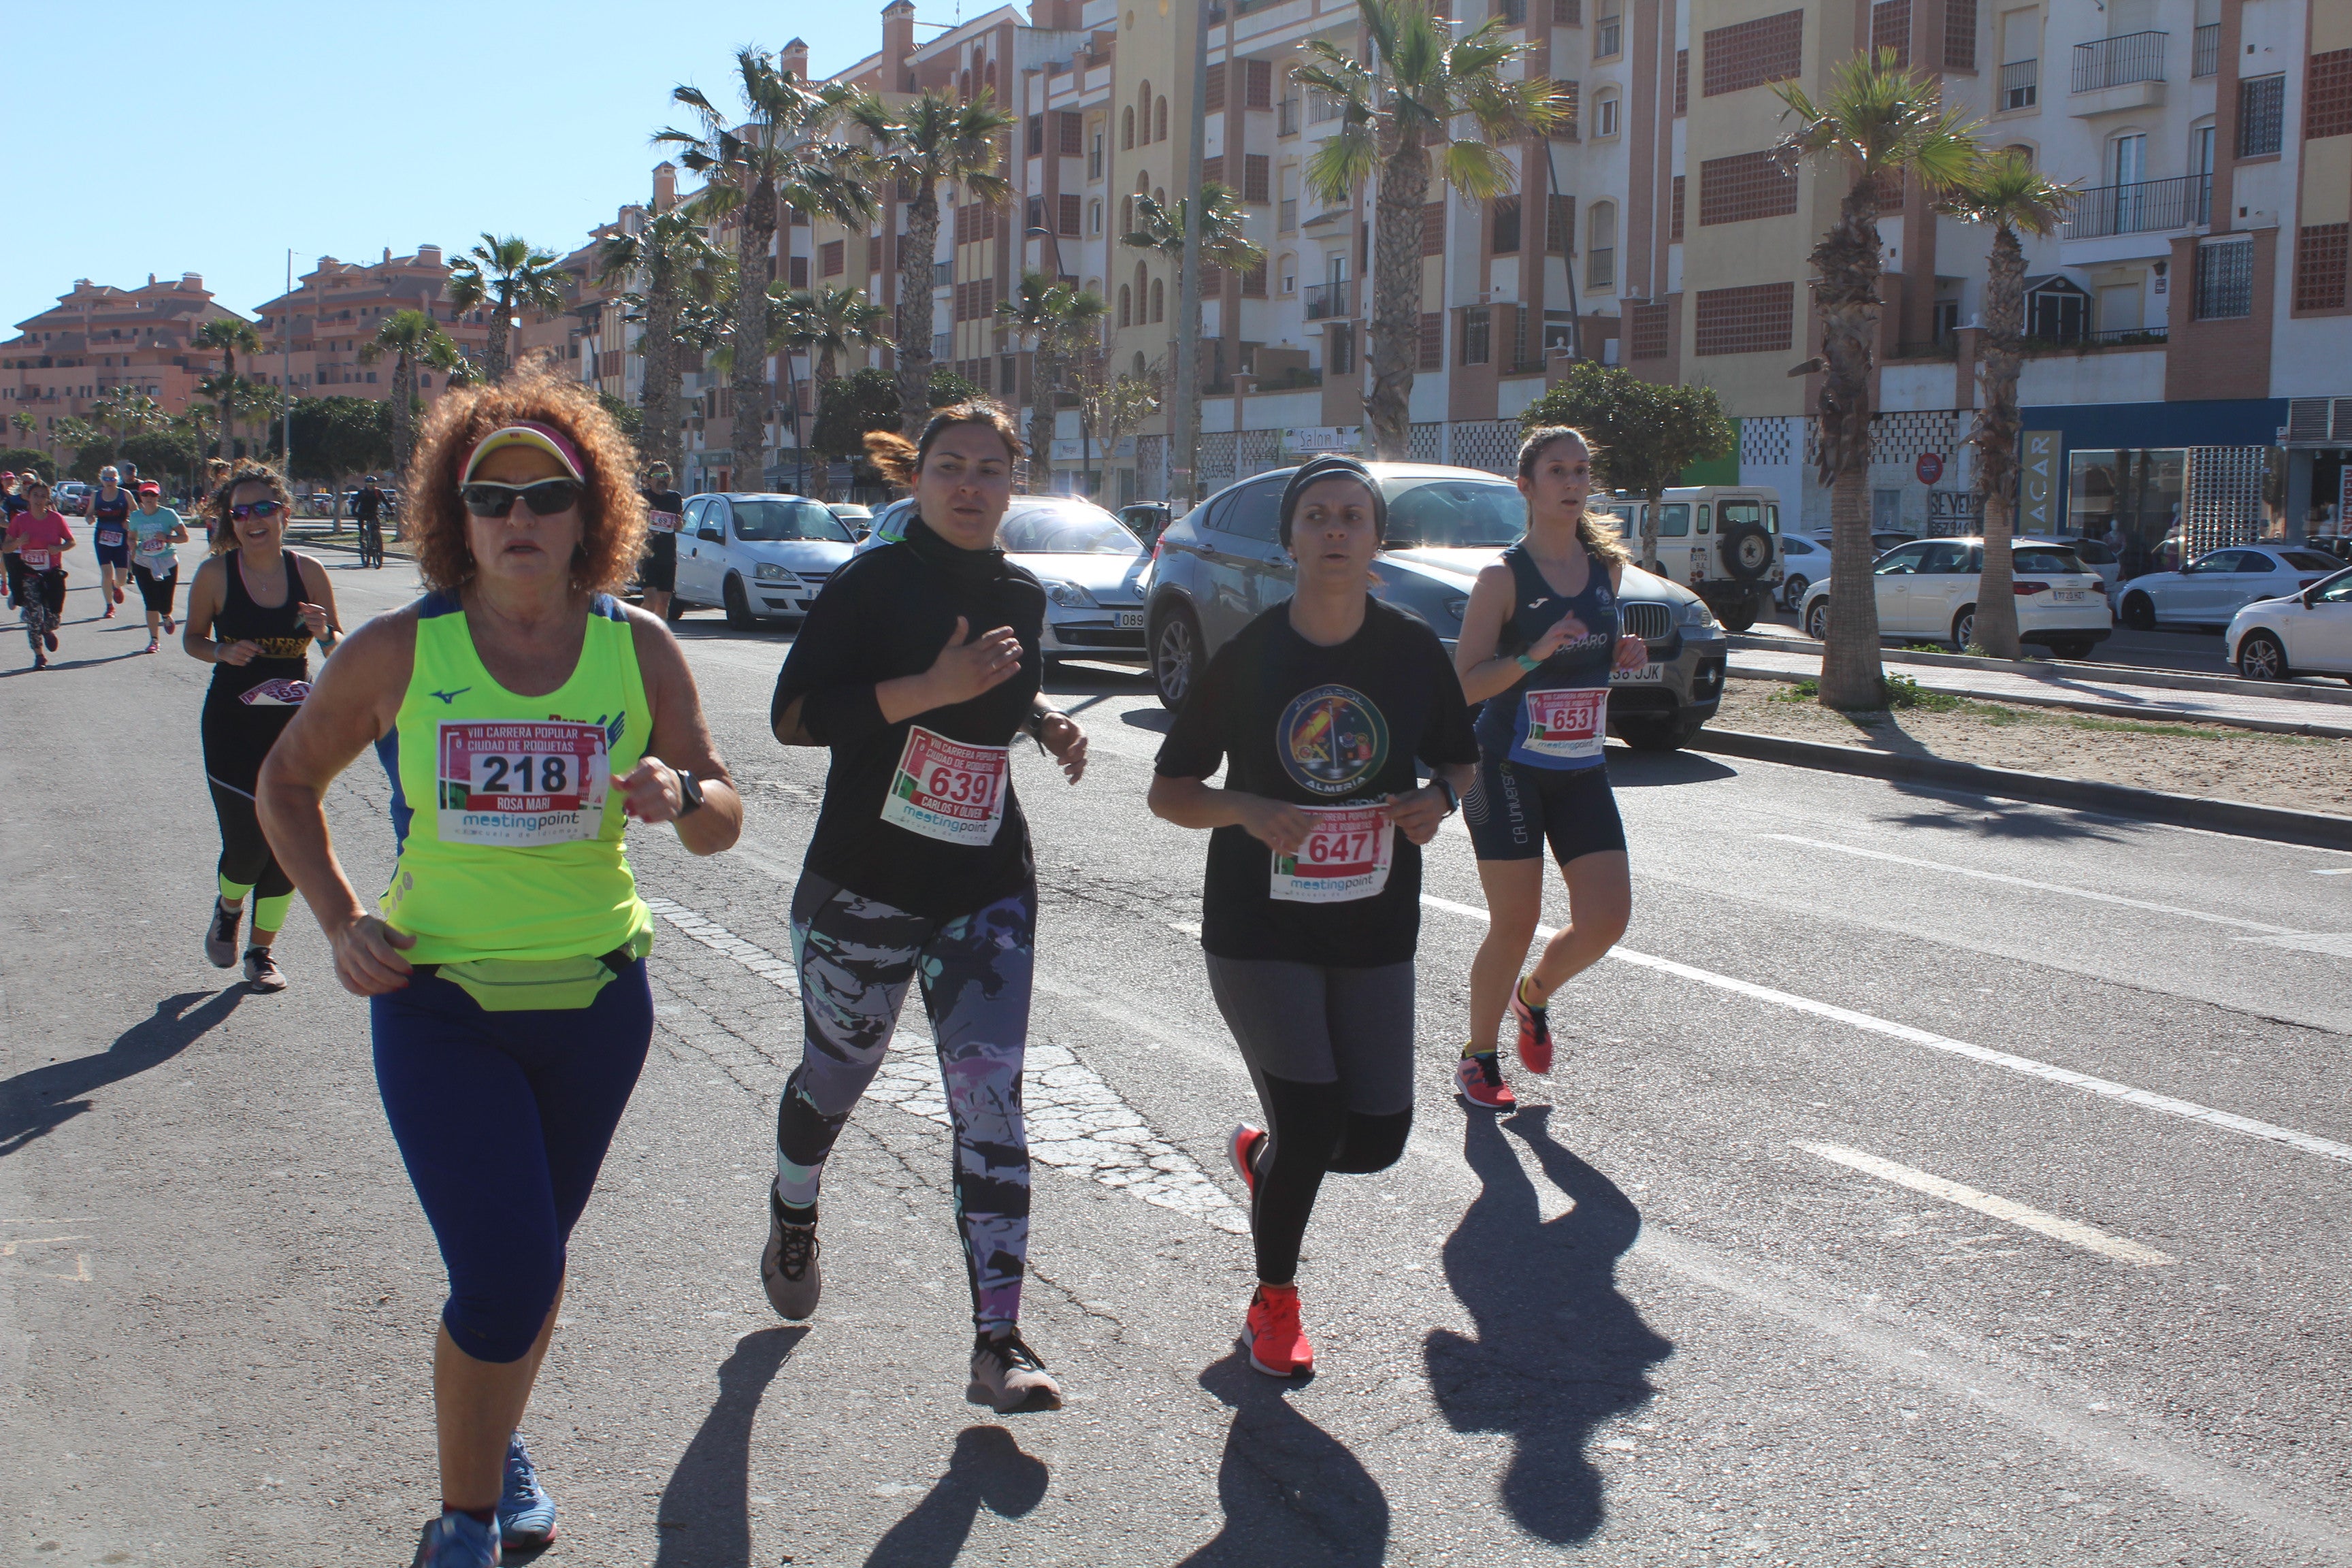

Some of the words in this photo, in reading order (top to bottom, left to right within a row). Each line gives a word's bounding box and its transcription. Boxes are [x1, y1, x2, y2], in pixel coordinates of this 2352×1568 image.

[1301, 429, 1331, 446] Salon
[1947, 493, 1978, 514] VEN
[1123, 615, 1143, 625] 089
[1553, 708, 1588, 730] 653
[468, 728, 483, 738] VIII
[487, 727, 532, 738] CARRERA
[535, 728, 578, 740] POPULAR
[468, 740, 506, 751] CIUDAD
[508, 740, 520, 751] DE
[523, 740, 574, 753] ROQUETAS
[930, 738, 941, 749] VIII
[942, 743, 975, 759] CARRERA
[926, 749, 953, 765] CIUDAD
[954, 760, 964, 768] DE
[483, 755, 567, 793] 218
[929, 767, 988, 804] 639
[497, 797, 523, 810] ROSA
[921, 796, 953, 813] CARLOS
[953, 805, 960, 815] Y
[1309, 834, 1368, 863] 647
